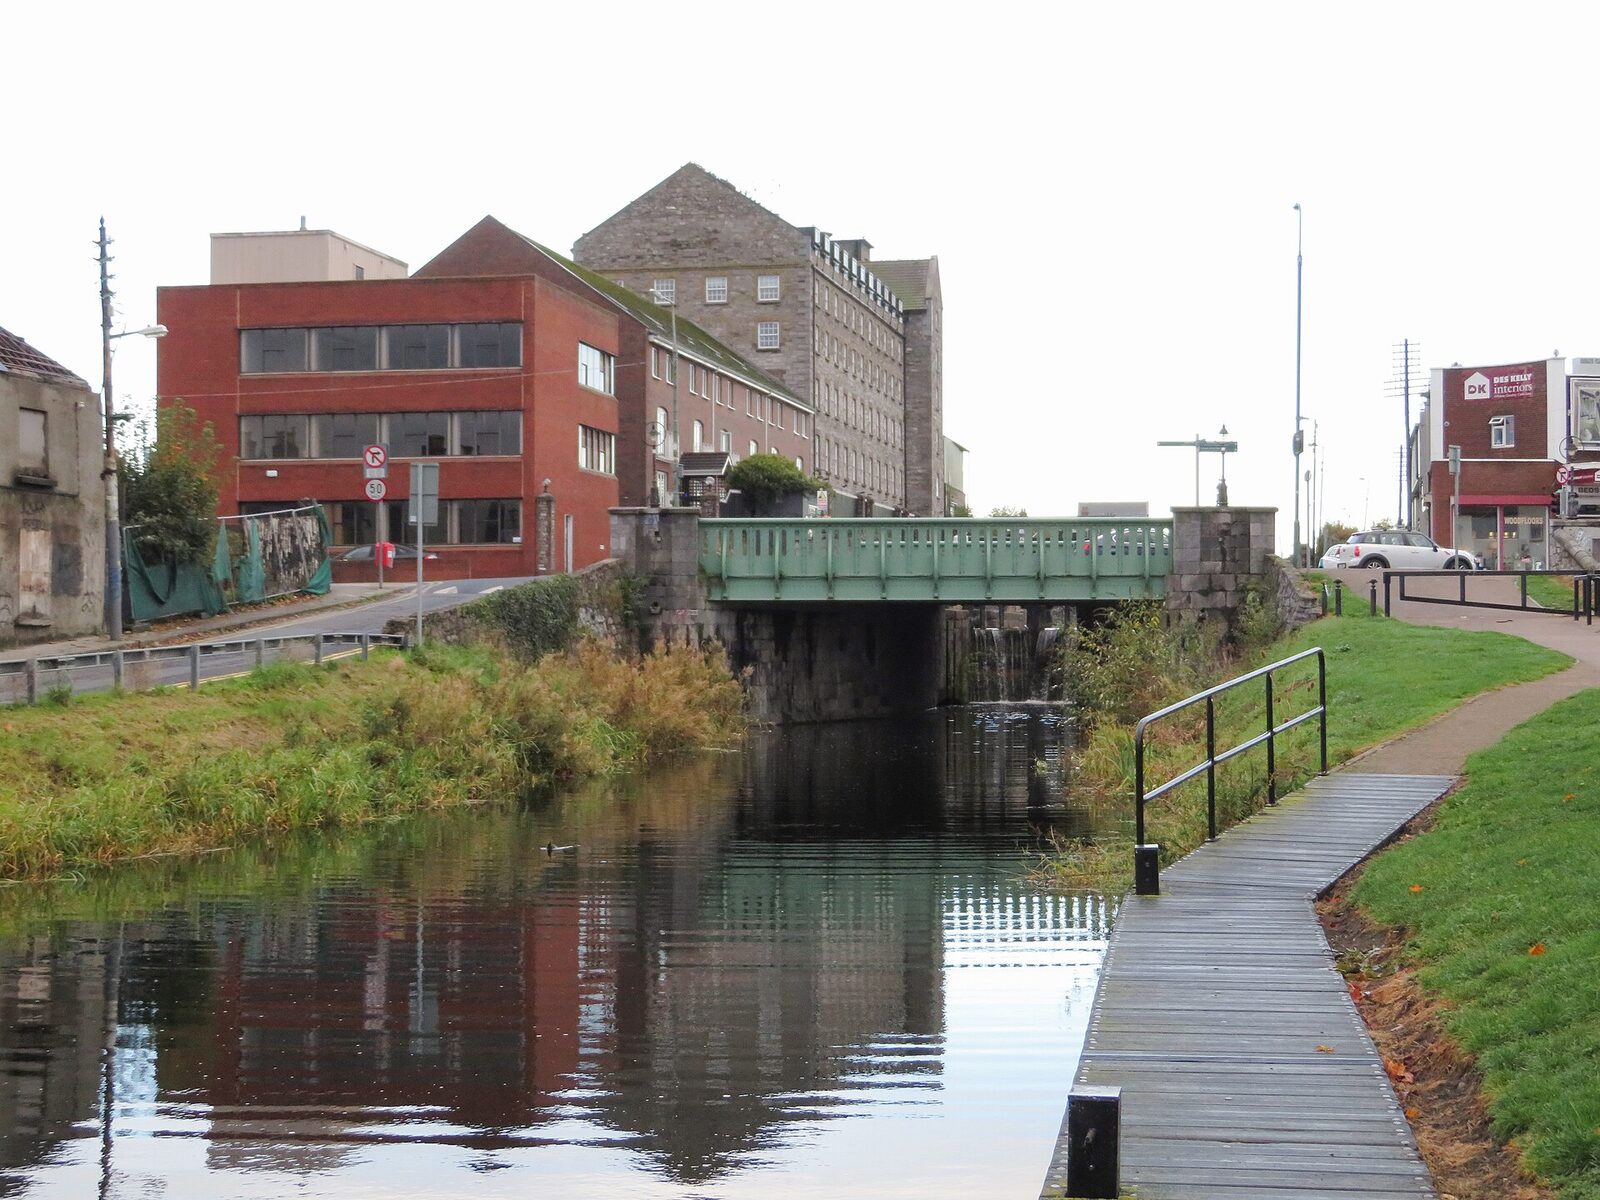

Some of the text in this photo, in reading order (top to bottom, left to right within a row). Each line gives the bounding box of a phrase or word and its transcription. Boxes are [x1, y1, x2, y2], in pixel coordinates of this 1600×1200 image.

[1510, 373, 1532, 382] KELLY
[1467, 384, 1487, 394] DK
[1493, 382, 1533, 393] interiors
[369, 483, 382, 494] 50
[1504, 516, 1543, 524] WOODFLOORS
